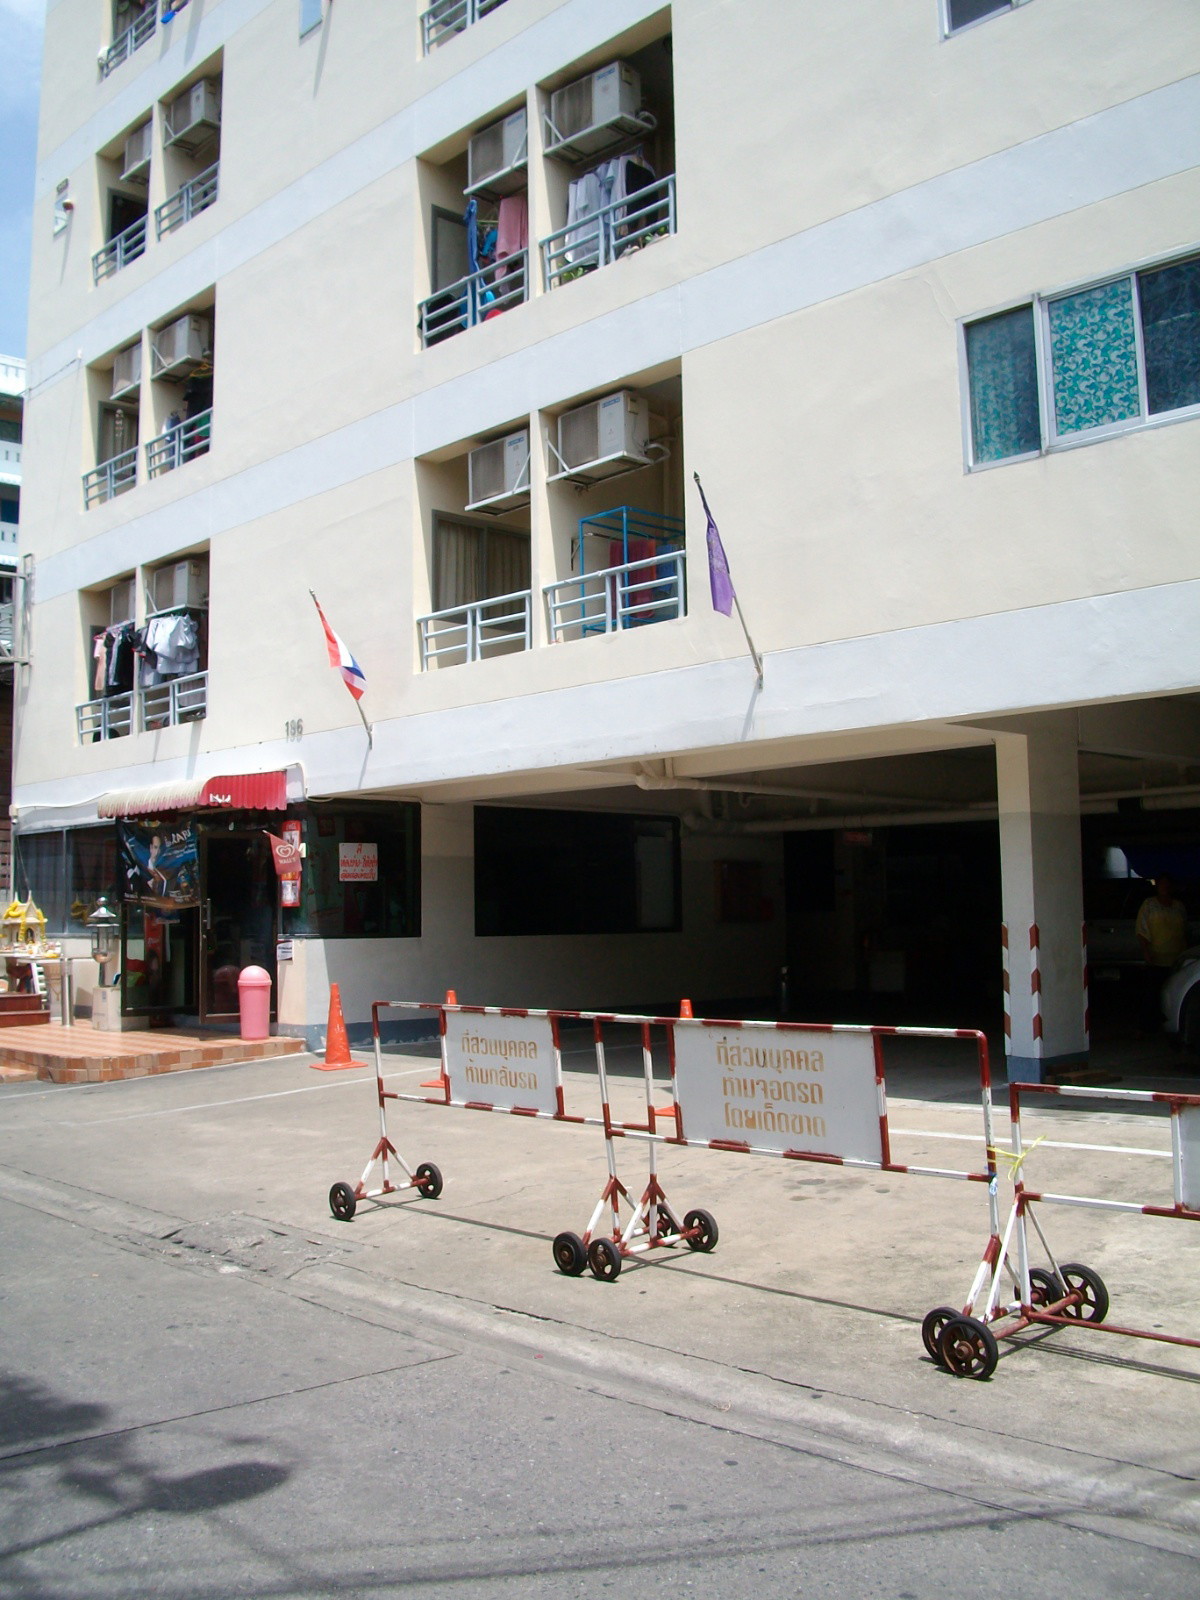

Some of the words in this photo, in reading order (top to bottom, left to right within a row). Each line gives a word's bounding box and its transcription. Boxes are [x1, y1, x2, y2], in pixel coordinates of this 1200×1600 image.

[461, 1029, 538, 1060] ที่ส่วนบุคคล
[715, 1036, 825, 1074] ที่ส่วนบุคคล
[465, 1058, 538, 1090] ห้ามกลับรถ
[722, 1067, 824, 1104] ห้ามจอดรถ
[724, 1102, 827, 1138] โดยเด็ดขาด
